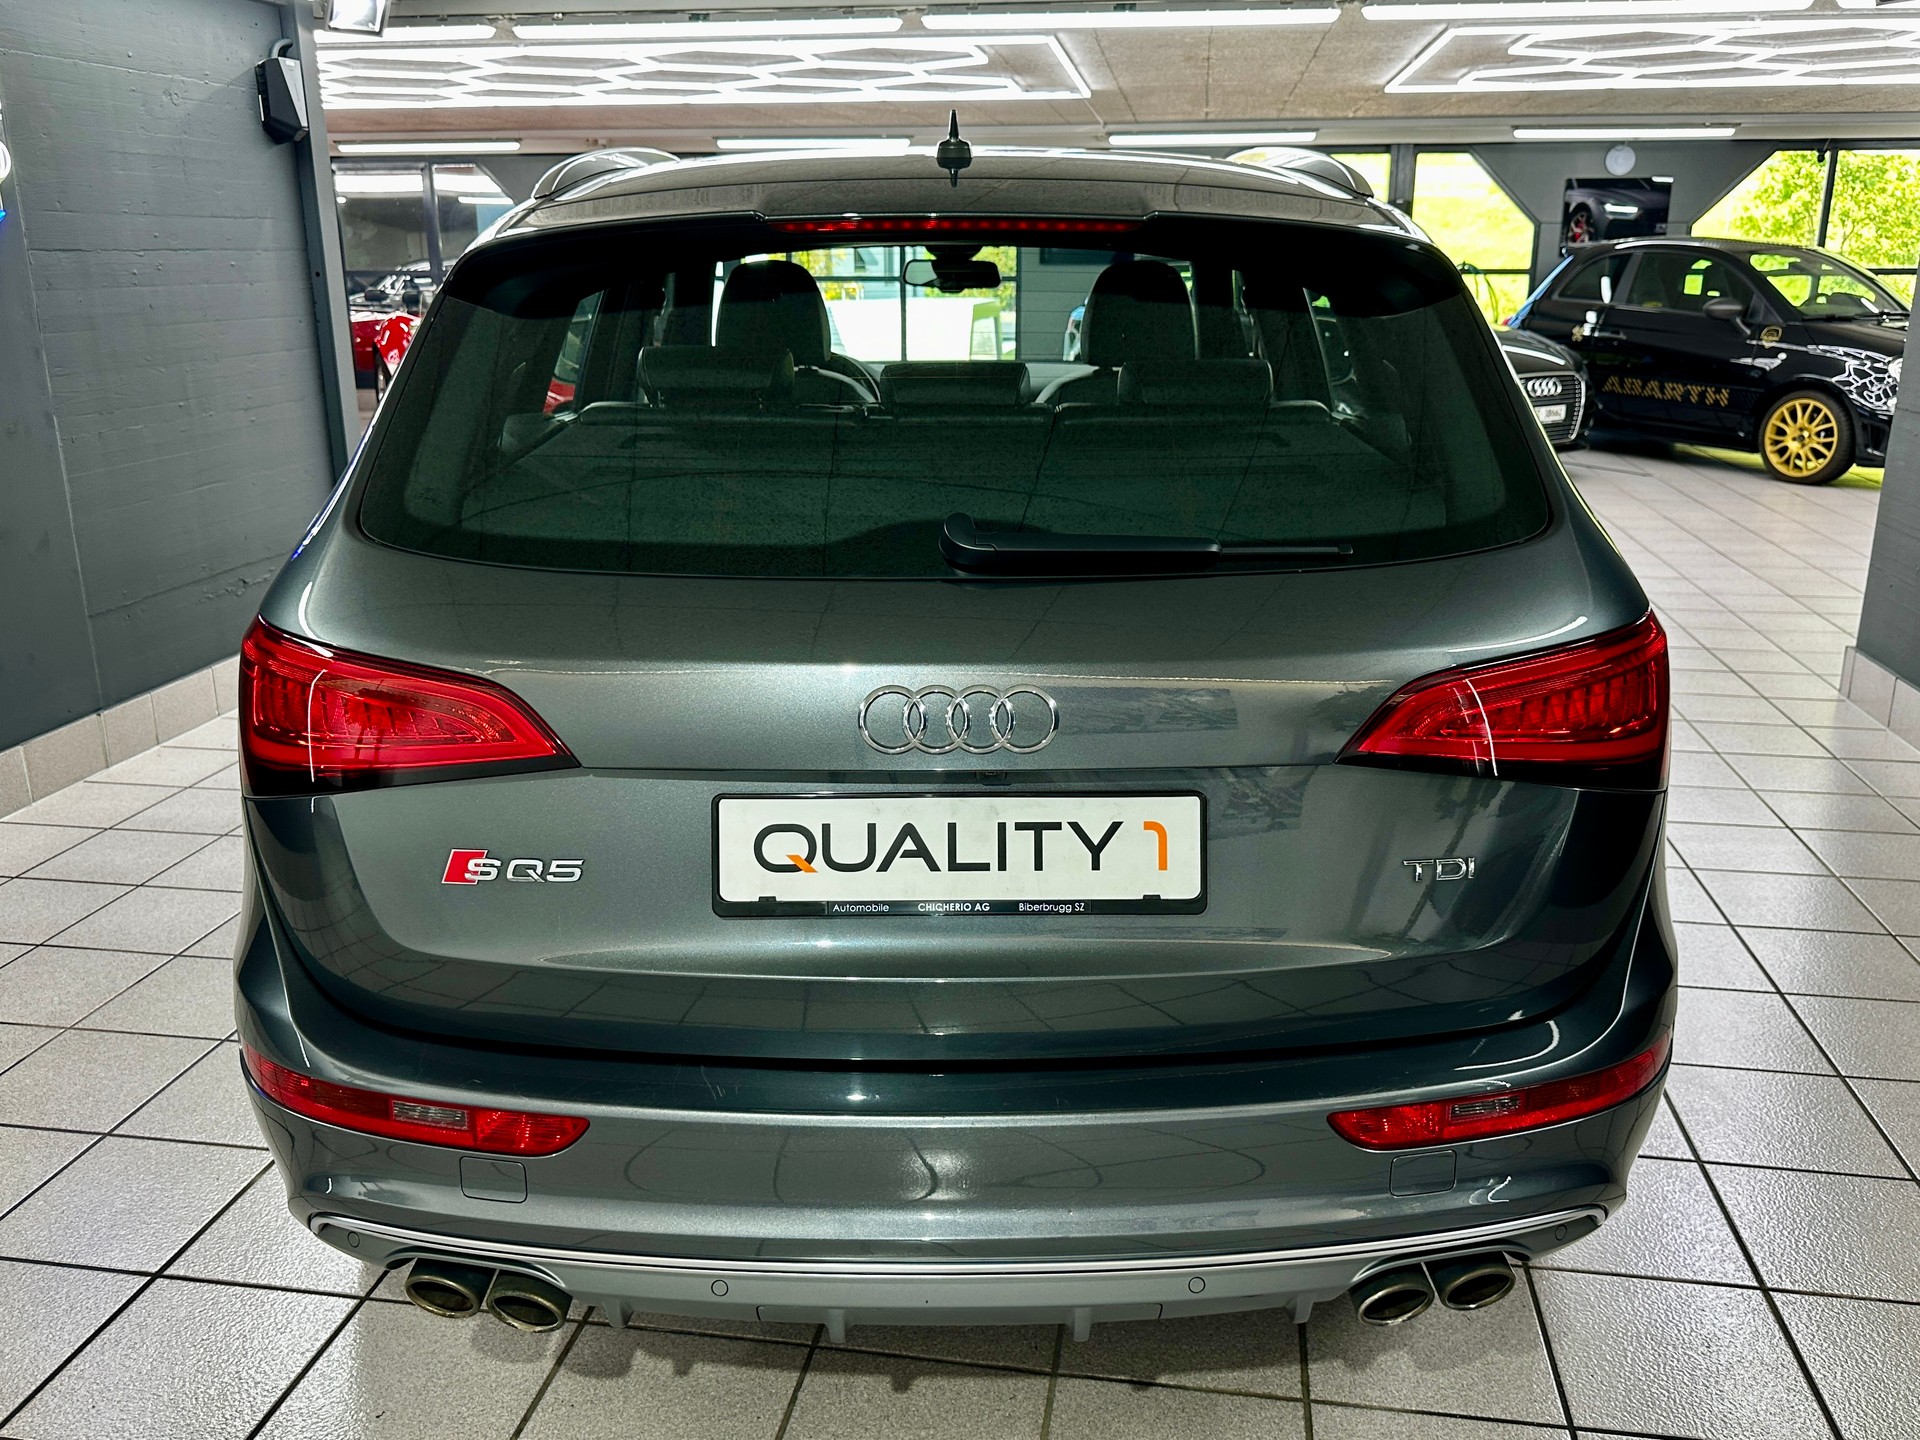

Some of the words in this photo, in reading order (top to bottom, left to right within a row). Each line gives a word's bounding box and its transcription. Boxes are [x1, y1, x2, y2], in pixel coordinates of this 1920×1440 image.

[1602, 376, 1730, 407] ABARTH
[753, 821, 1124, 873] QUALITY
[1143, 821, 1168, 871] 1
[464, 858, 585, 883] SQ5
[1403, 857, 1475, 881] TDI
[832, 903, 890, 912] Automobile
[918, 902, 972, 912] CHICHERIO
[974, 902, 990, 911] AG
[1018, 902, 1072, 913] Biberbrugg
[1074, 902, 1085, 911] SZ
